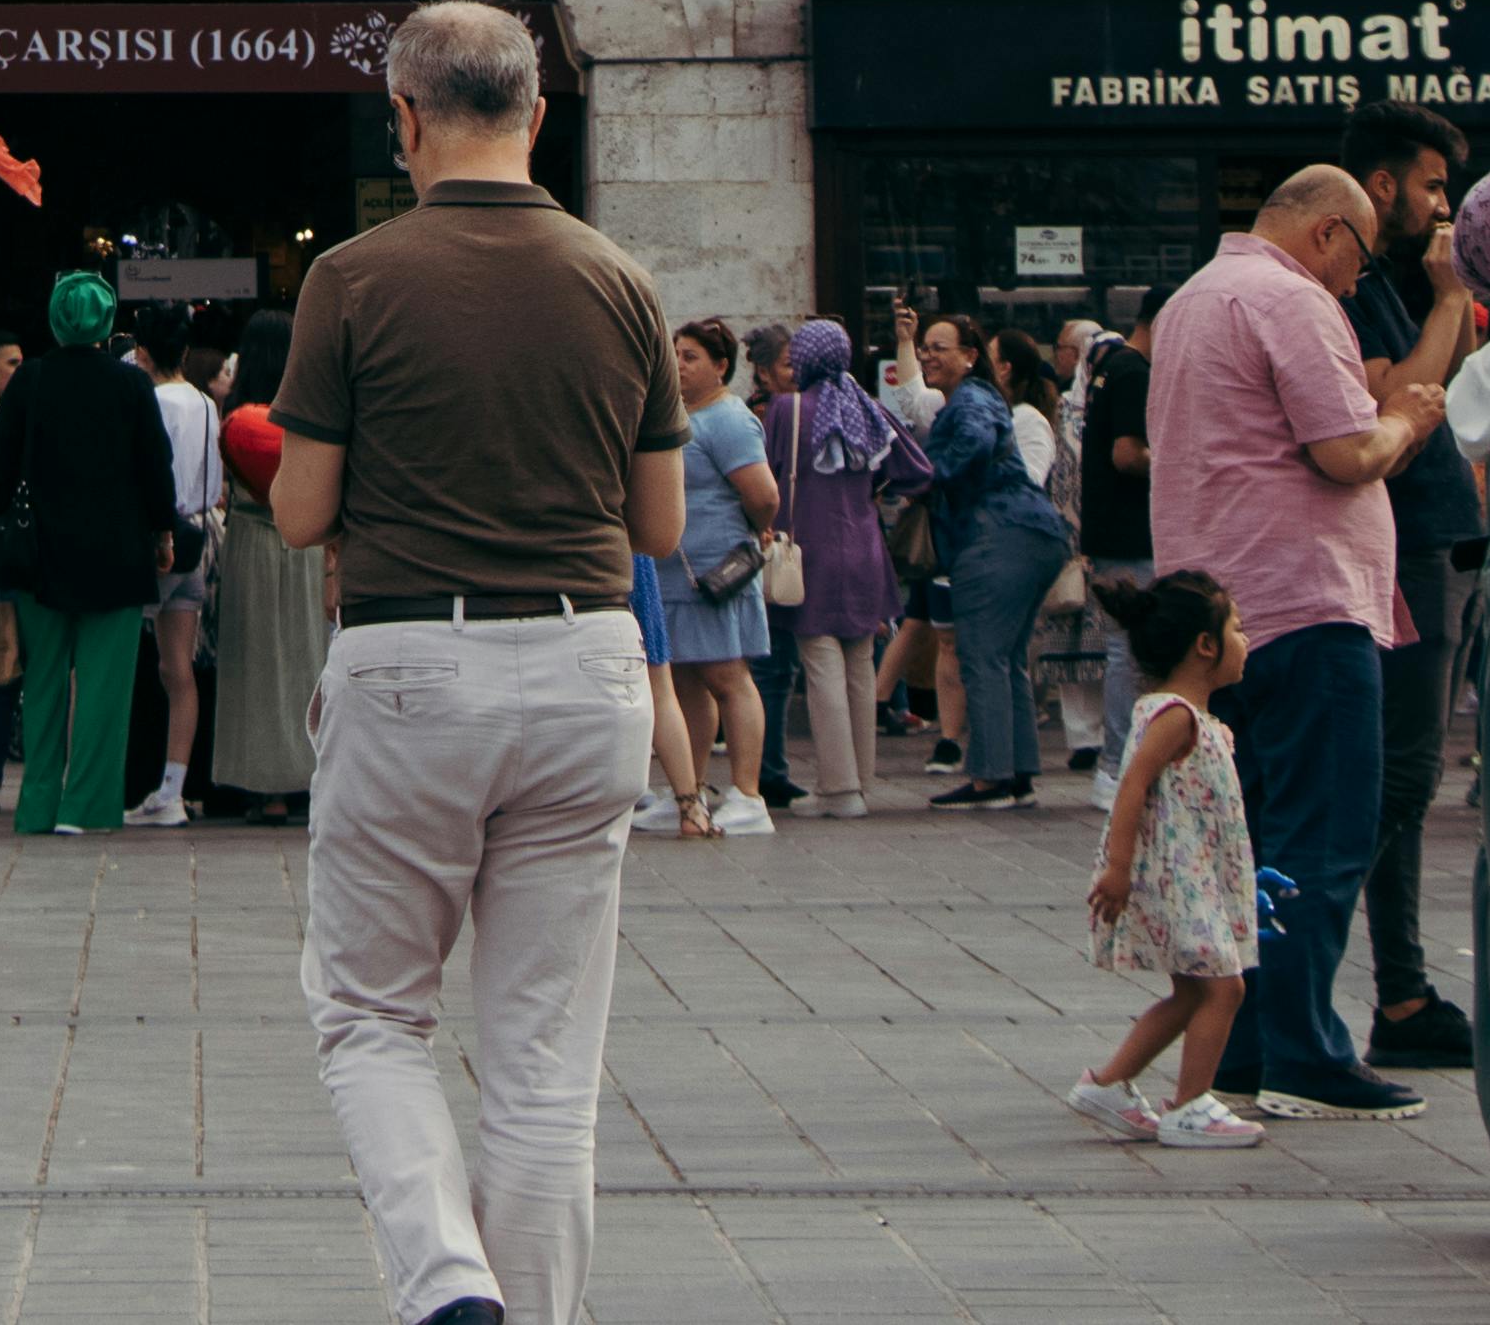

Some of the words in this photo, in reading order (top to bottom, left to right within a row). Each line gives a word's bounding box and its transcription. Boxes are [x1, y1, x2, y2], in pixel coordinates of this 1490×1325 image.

[190, 28, 316, 69] (1664)
[1051, 69, 1220, 106] FABRİKA
[1247, 75, 1361, 112] SATIŞ
